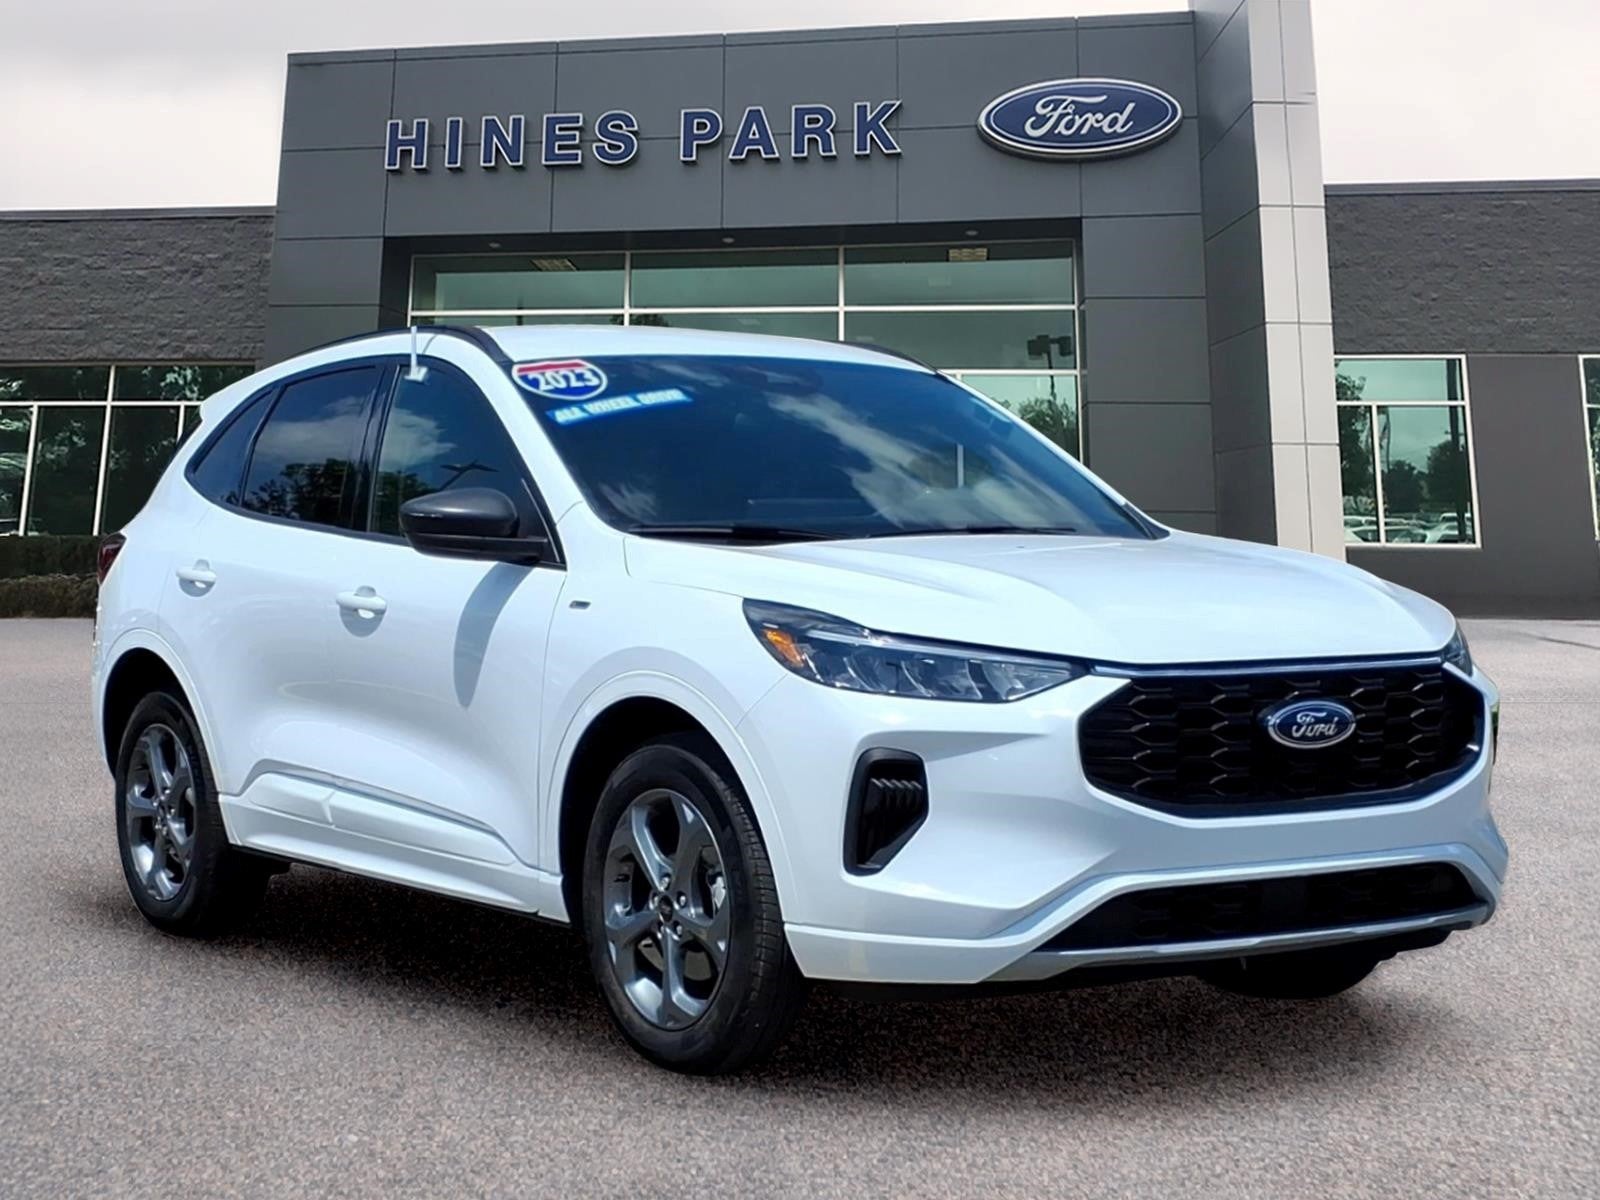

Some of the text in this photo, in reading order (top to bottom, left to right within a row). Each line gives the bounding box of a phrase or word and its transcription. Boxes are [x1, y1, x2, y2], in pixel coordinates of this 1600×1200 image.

[1024, 95, 1136, 138] Ford
[384, 100, 902, 171] HINES PARK
[529, 369, 600, 391] 2023
[1292, 711, 1339, 738] Ford
